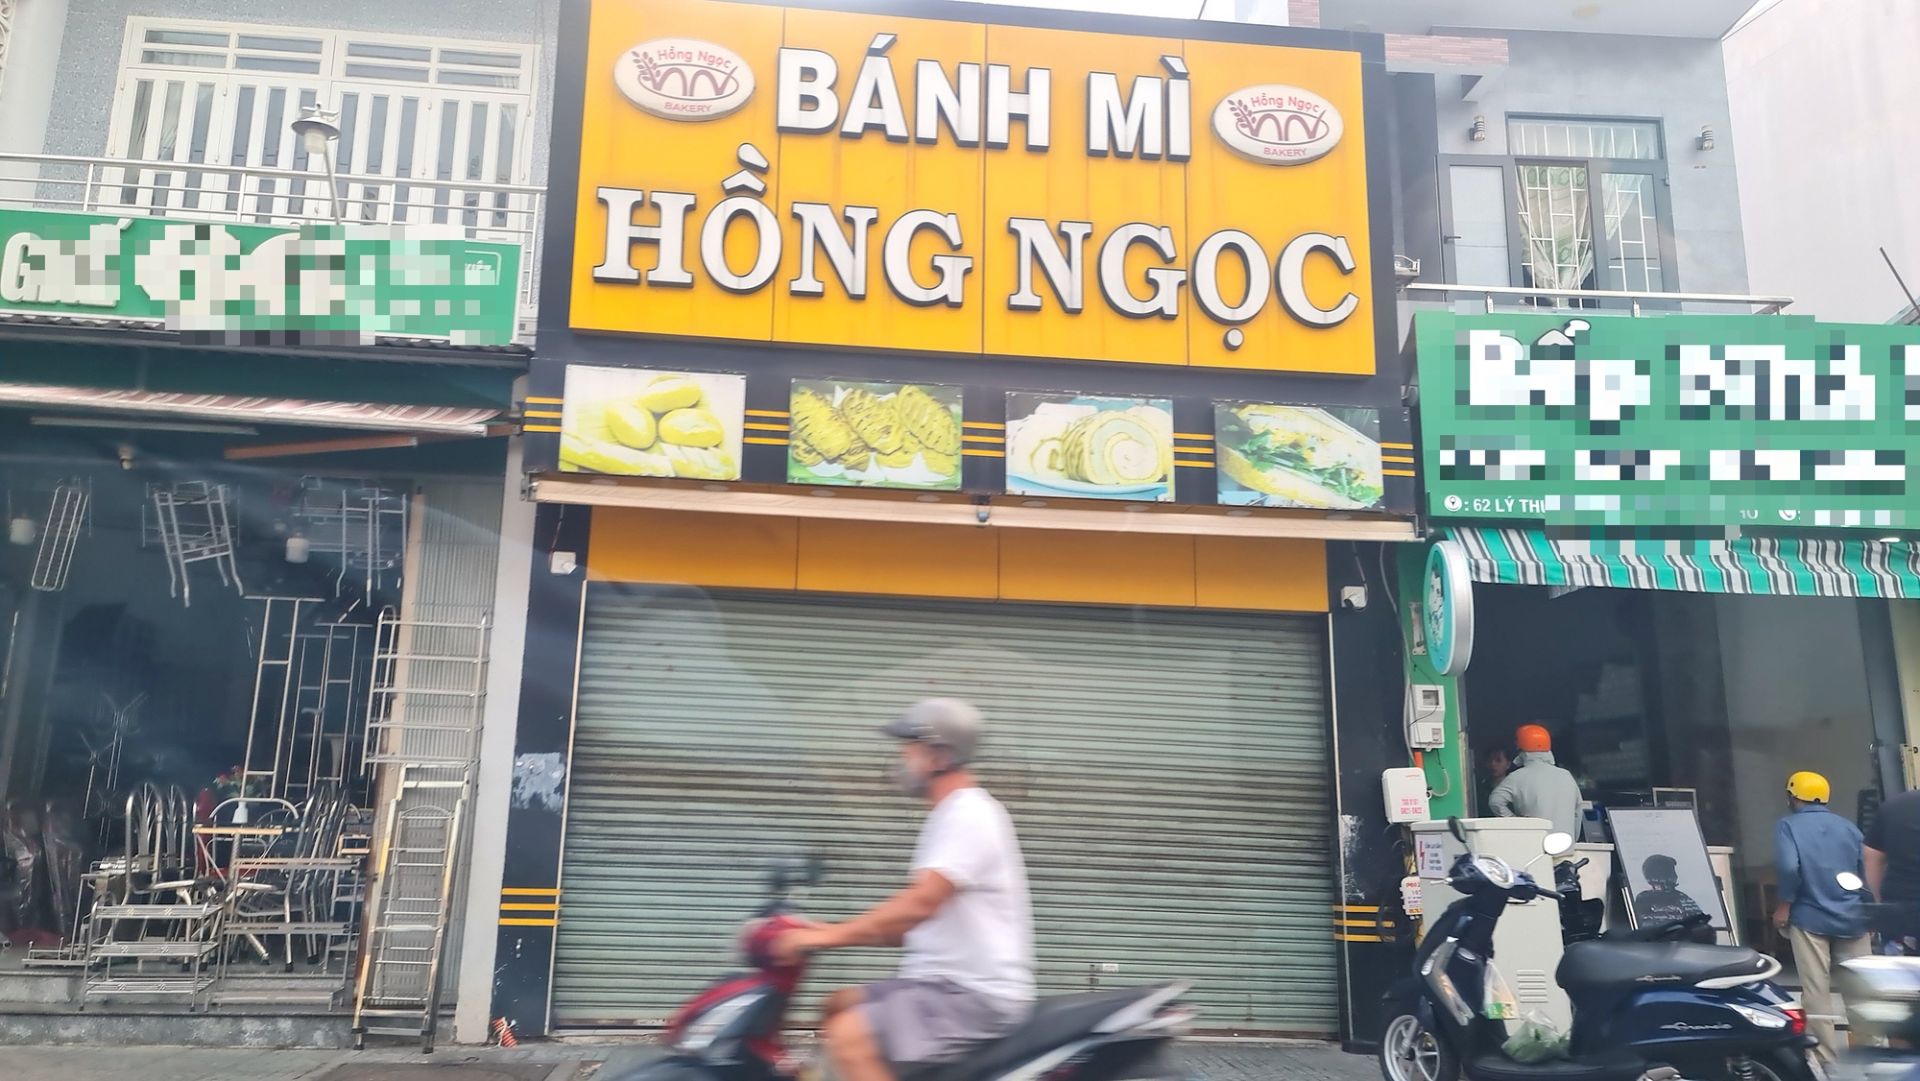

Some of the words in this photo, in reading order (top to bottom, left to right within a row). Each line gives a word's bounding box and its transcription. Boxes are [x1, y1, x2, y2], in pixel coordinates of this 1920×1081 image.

[657, 46, 693, 62] Hồng
[697, 50, 732, 68] Ngọc
[664, 101, 713, 113] BAKERY
[778, 33, 1049, 151] BÁNH
[1087, 55, 1191, 162] MÌ
[1251, 92, 1284, 108] Hồng
[1288, 96, 1321, 113] Ngọc
[1263, 147, 1308, 157] BAKERY
[593, 142, 974, 307] HỒNG
[1008, 216, 1361, 351] NGỌC
[1473, 498, 1491, 512] 62
[1495, 496, 1515, 513] LÝ
